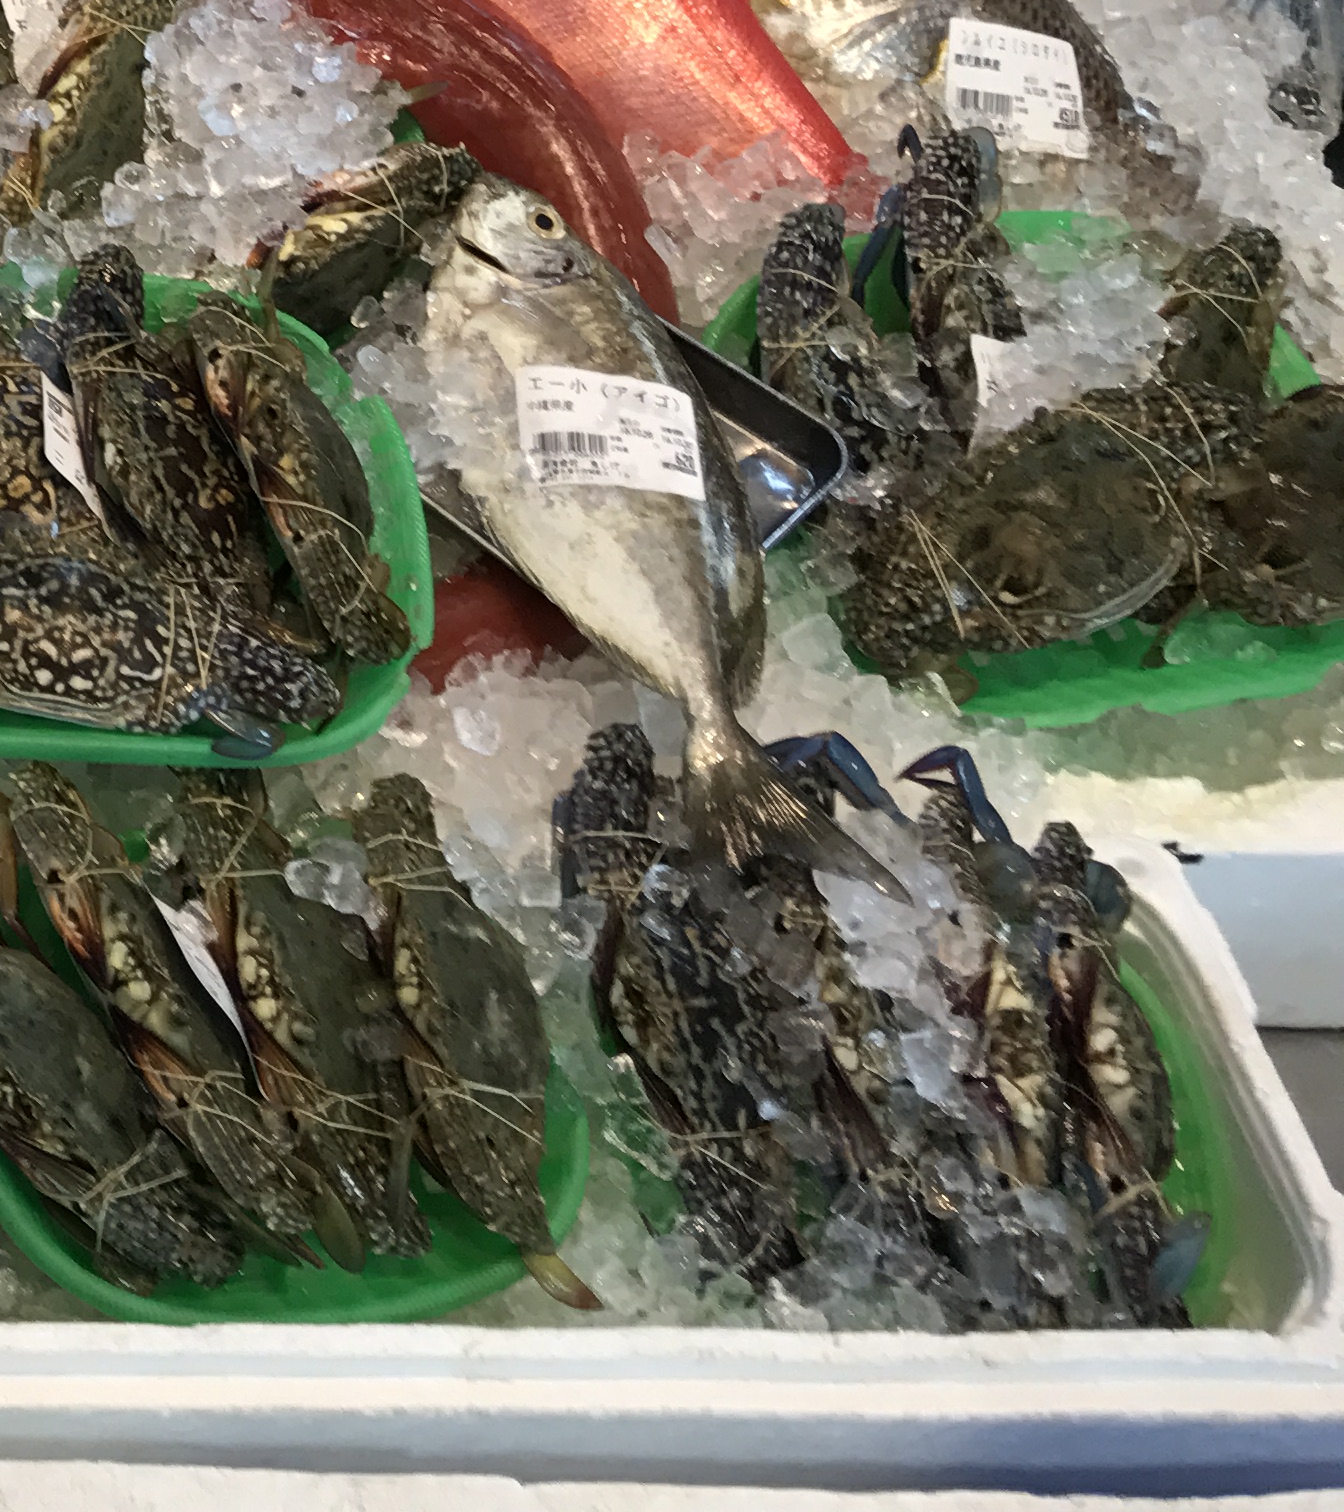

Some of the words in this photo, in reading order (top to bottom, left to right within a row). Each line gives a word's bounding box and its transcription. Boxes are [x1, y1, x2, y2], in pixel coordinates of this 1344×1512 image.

[527, 377, 681, 413] エー小（アイゴ）
